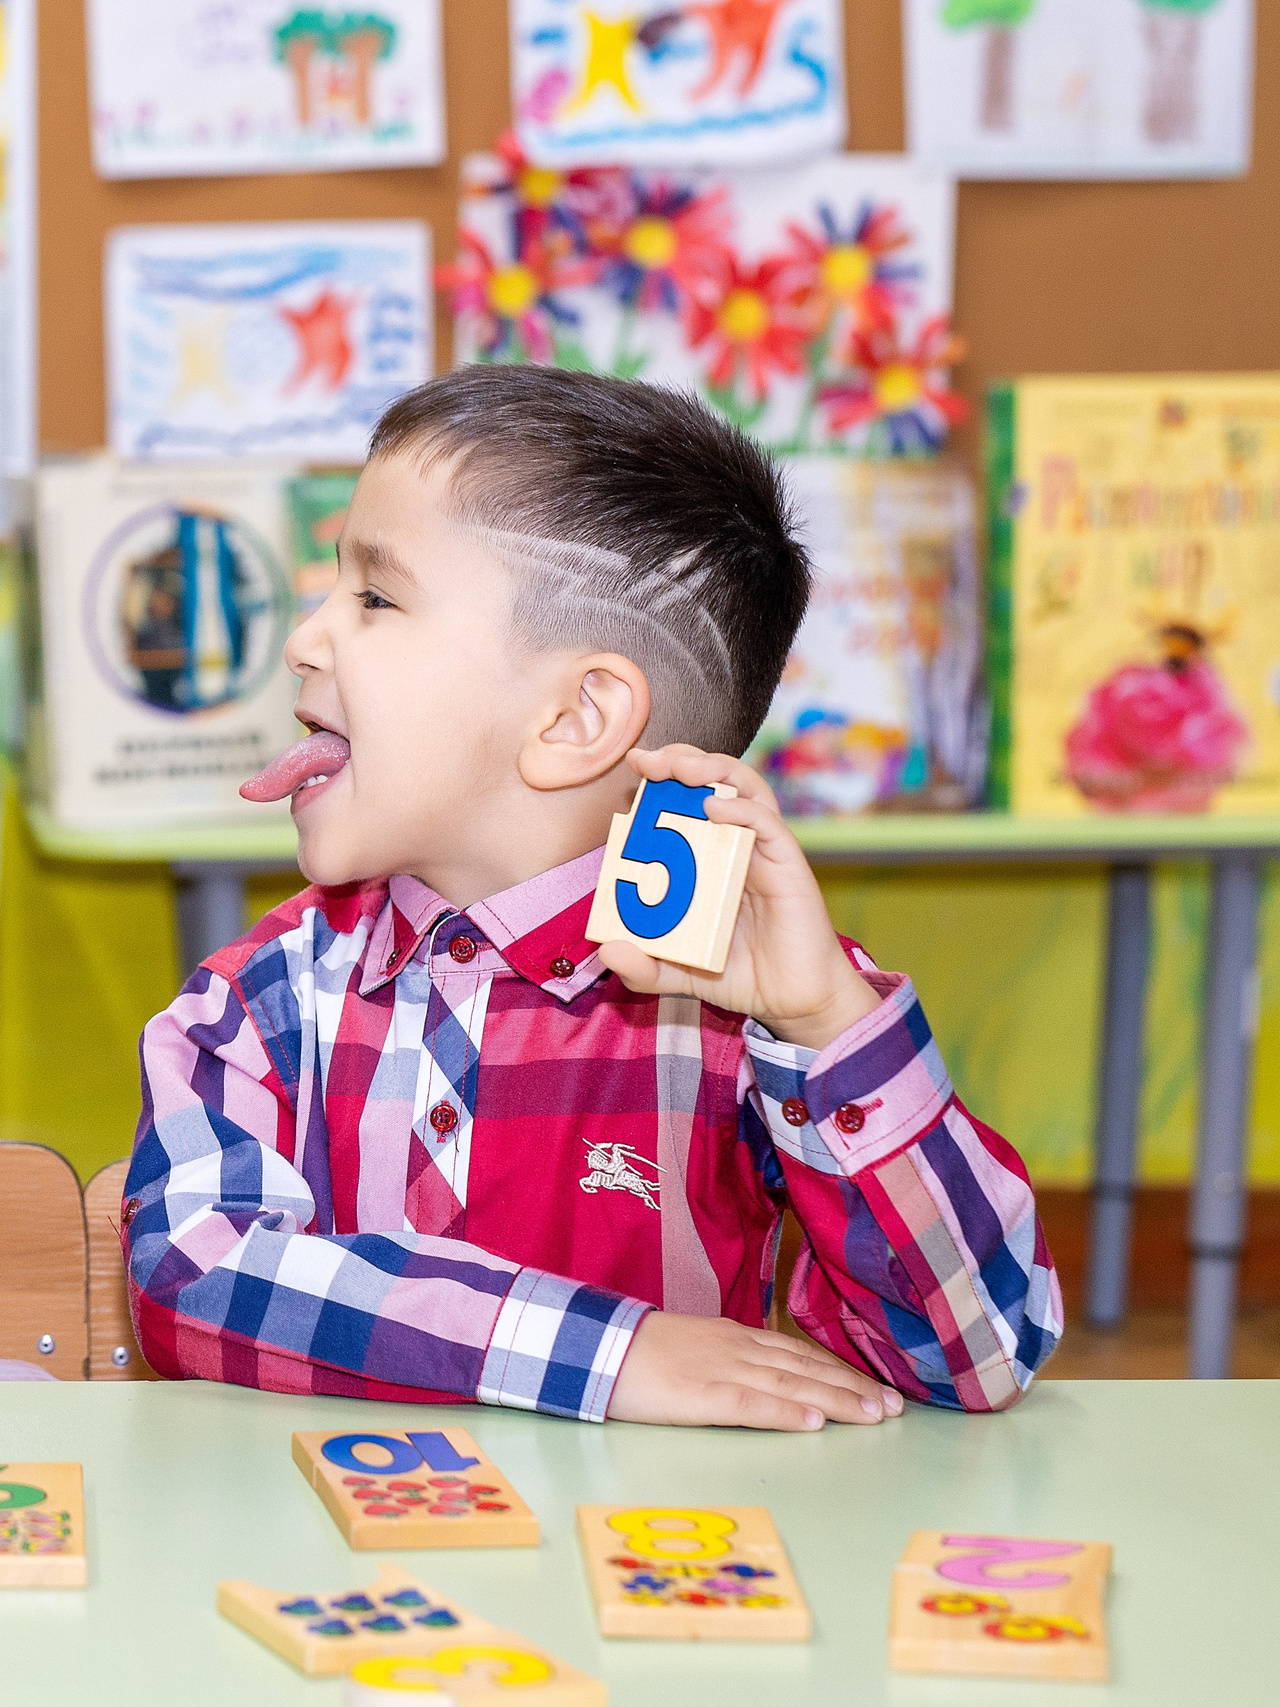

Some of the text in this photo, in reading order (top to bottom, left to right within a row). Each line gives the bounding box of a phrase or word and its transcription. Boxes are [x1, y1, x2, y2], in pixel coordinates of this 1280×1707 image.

[615, 778, 716, 940] 5
[320, 1431, 481, 1476] 10
[606, 1508, 738, 1560] 8
[936, 1535, 1086, 1589] 2
[349, 1645, 554, 1692] 3
